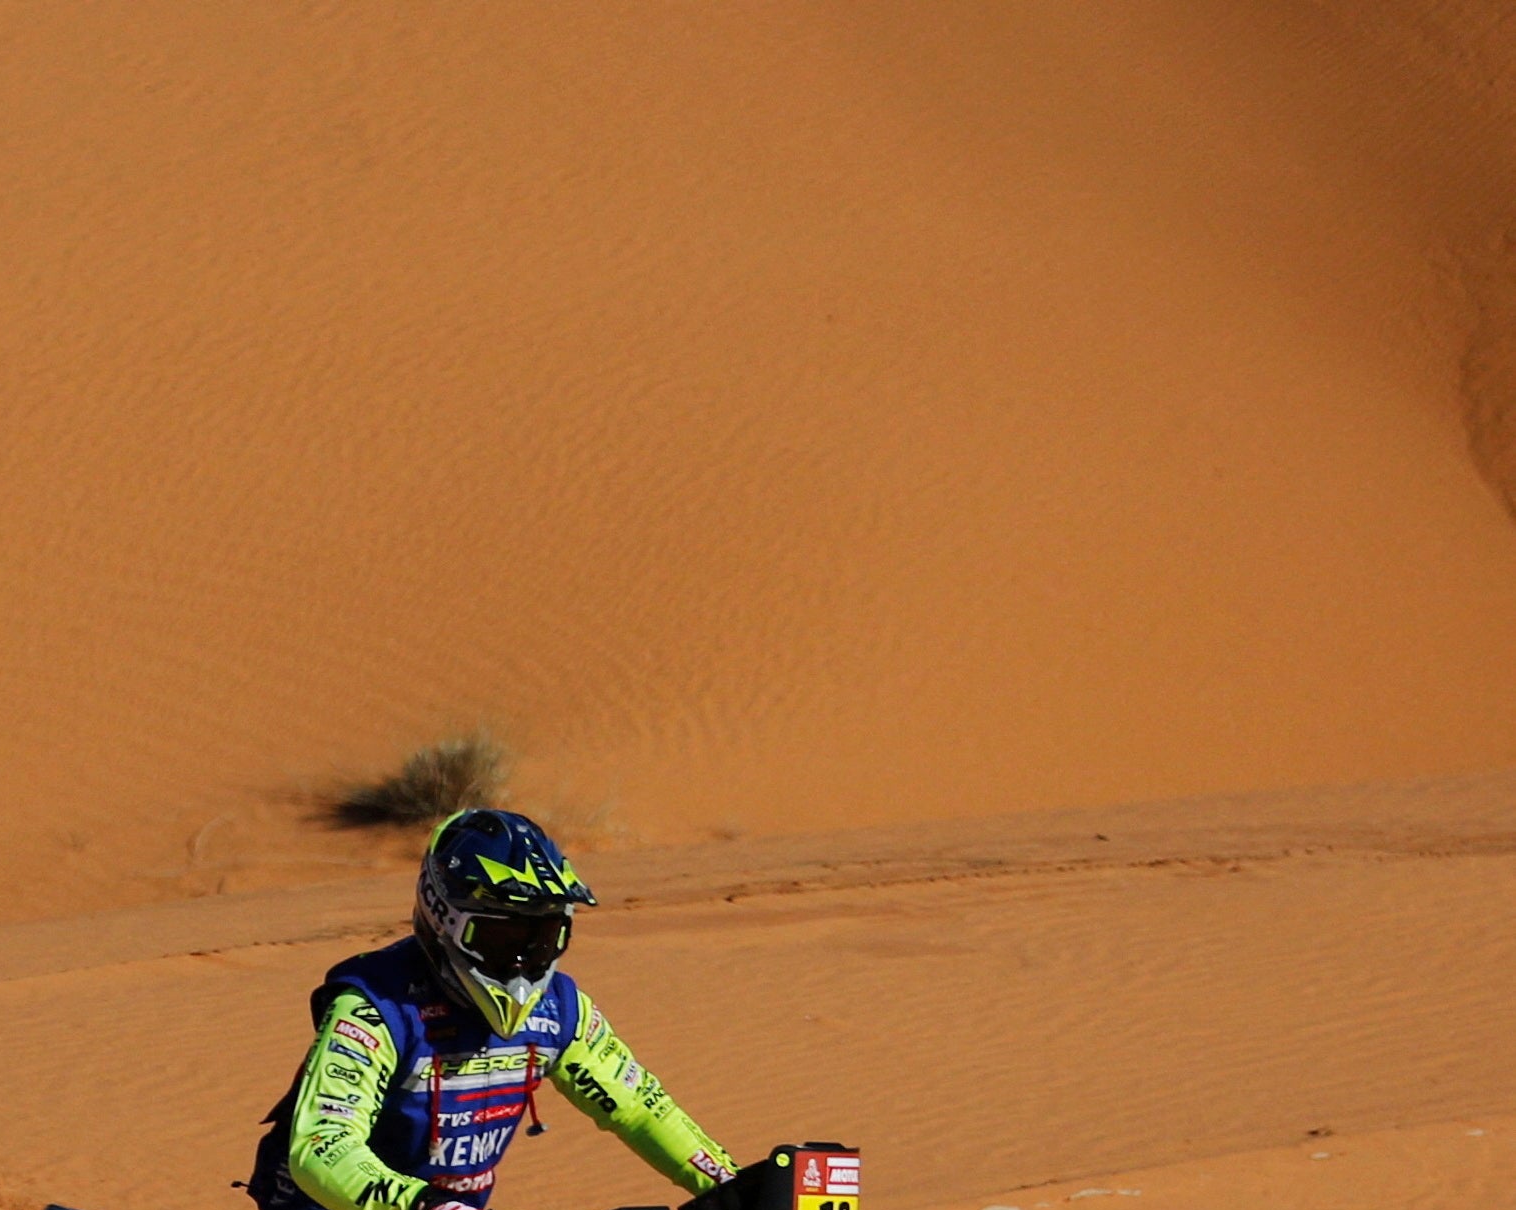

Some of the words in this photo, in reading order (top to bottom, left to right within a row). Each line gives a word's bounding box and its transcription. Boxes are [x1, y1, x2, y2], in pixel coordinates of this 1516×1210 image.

[420, 1053, 549, 1080] SHERCO
[436, 1111, 473, 1128] TVS
[428, 1125, 513, 1167] KENNY
